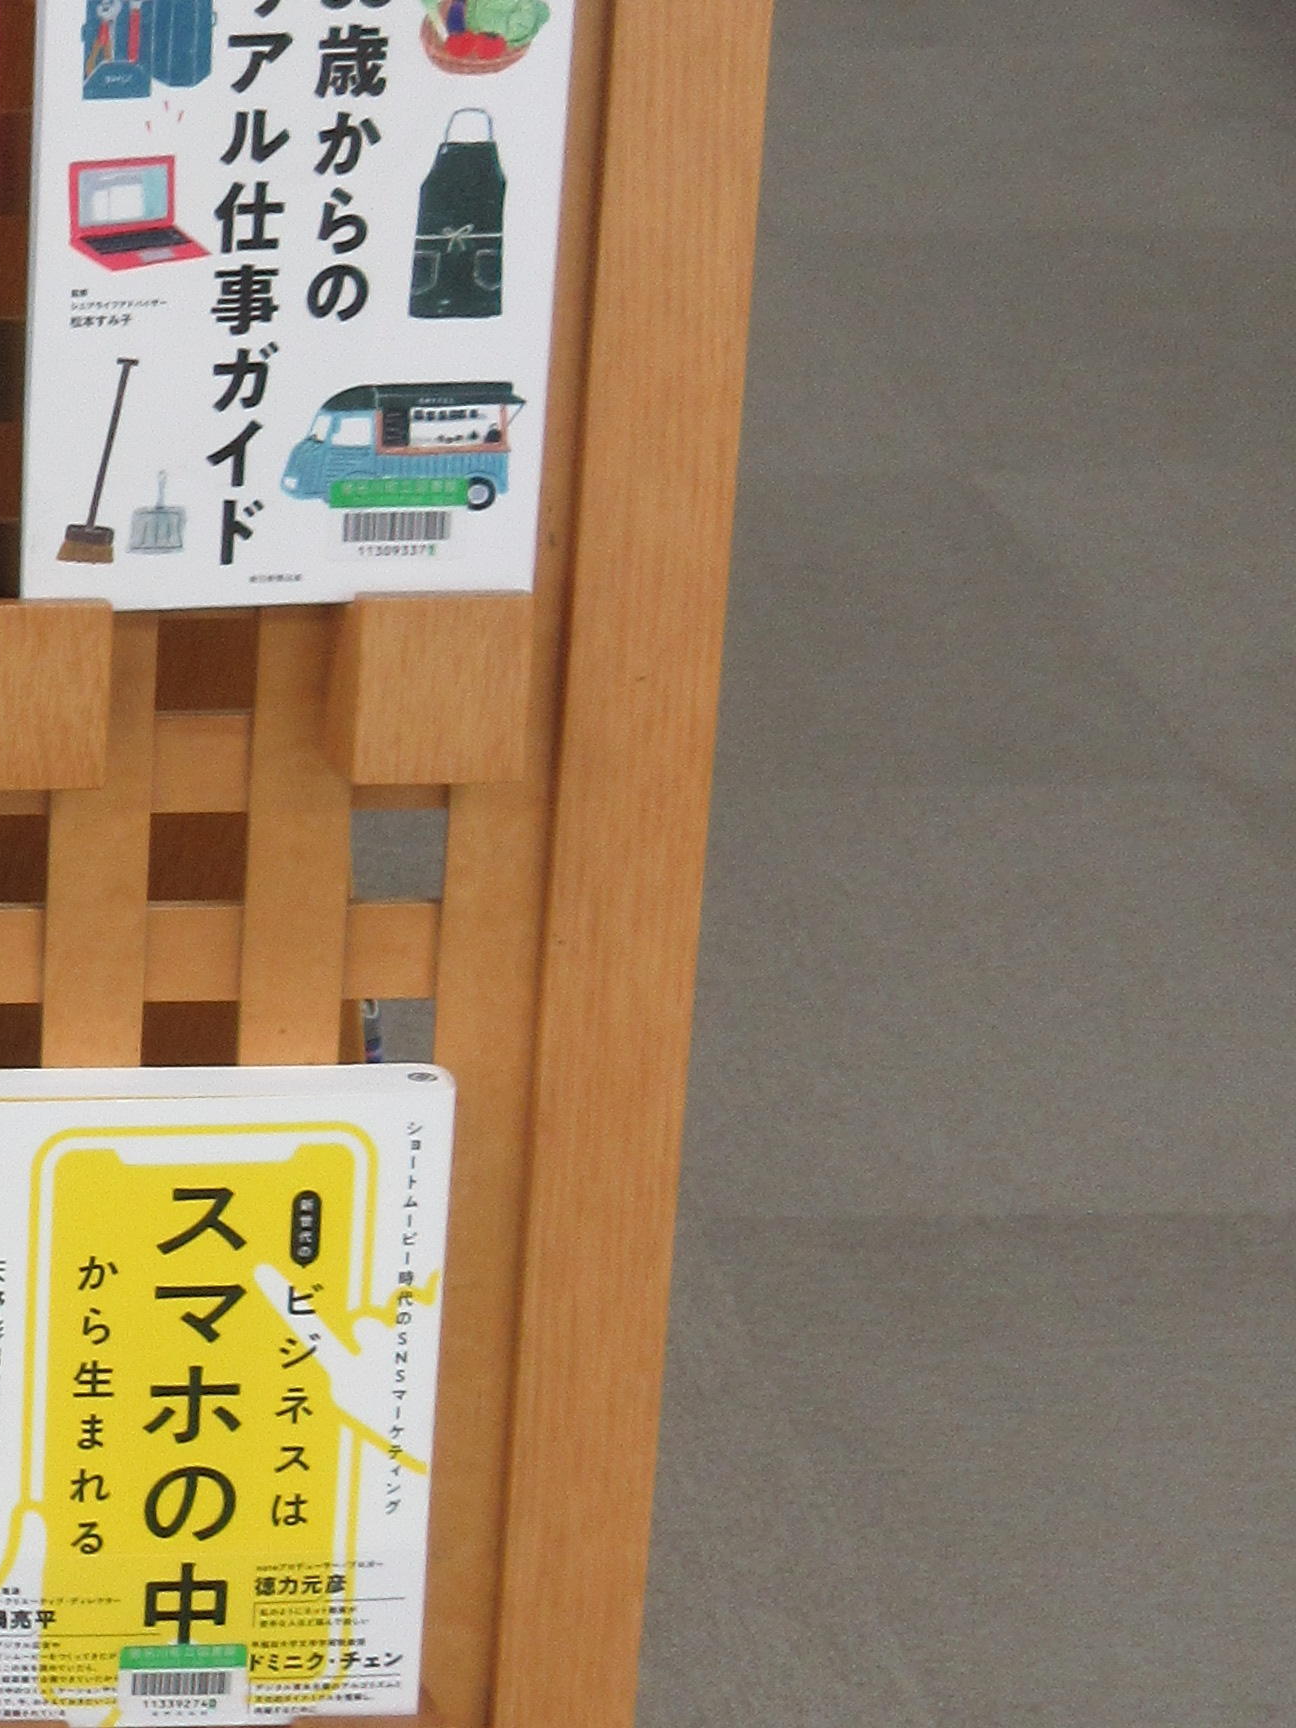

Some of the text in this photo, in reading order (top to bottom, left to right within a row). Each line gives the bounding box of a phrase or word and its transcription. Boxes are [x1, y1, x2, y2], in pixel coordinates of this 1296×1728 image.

[70, 1255, 119, 1556] から生まれる
[142, 1186, 248, 1645] スマホの中
[271, 1283, 322, 1528] ビジネスは
[249, 1651, 404, 1673] ドミニク・チェン
